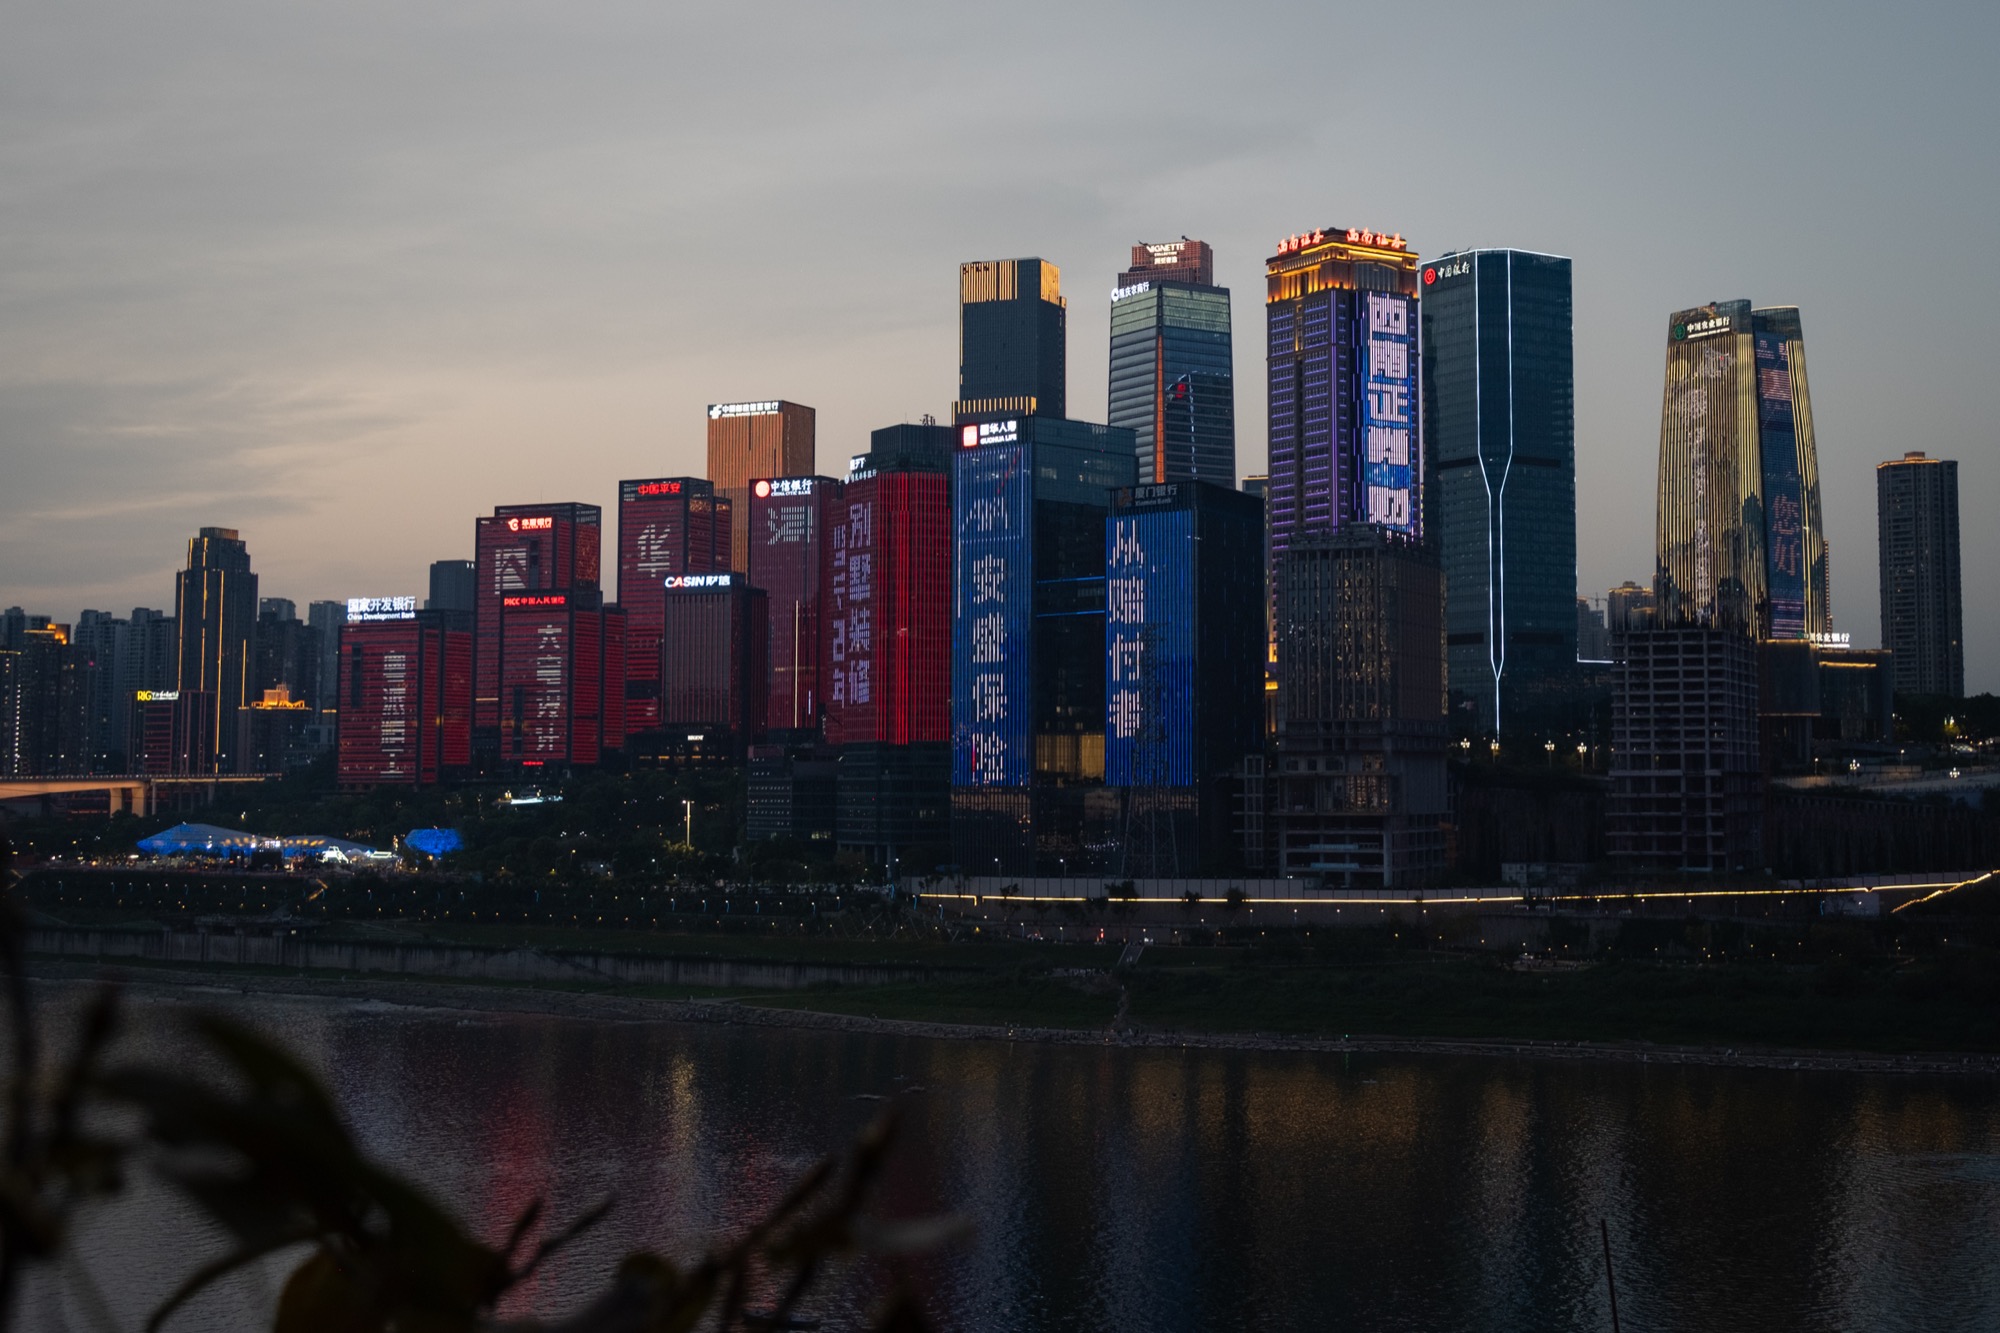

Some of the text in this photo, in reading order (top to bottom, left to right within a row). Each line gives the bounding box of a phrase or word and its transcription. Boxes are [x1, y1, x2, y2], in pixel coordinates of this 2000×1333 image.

[1278, 228, 1324, 254] 西南证券
[1346, 228, 1406, 249] 西南证券
[1146, 243, 1185, 253] VIGNETTE
[1438, 261, 1470, 279] 中国银行
[1687, 316, 1730, 333] 中国农业银行
[638, 483, 681, 495] 中国平安
[770, 479, 812, 492] 中信银行
[1135, 484, 1177, 499] 厦门银行
[1773, 494, 1800, 576] 您好
[665, 576, 705, 588] CASIN
[347, 596, 415, 612] 国家开发银行
[504, 595, 565, 606] PICC 中国人民保险
[849, 502, 871, 705] 别墅装修
[363, 613, 400, 621] Development
[401, 611, 415, 619] Bank
